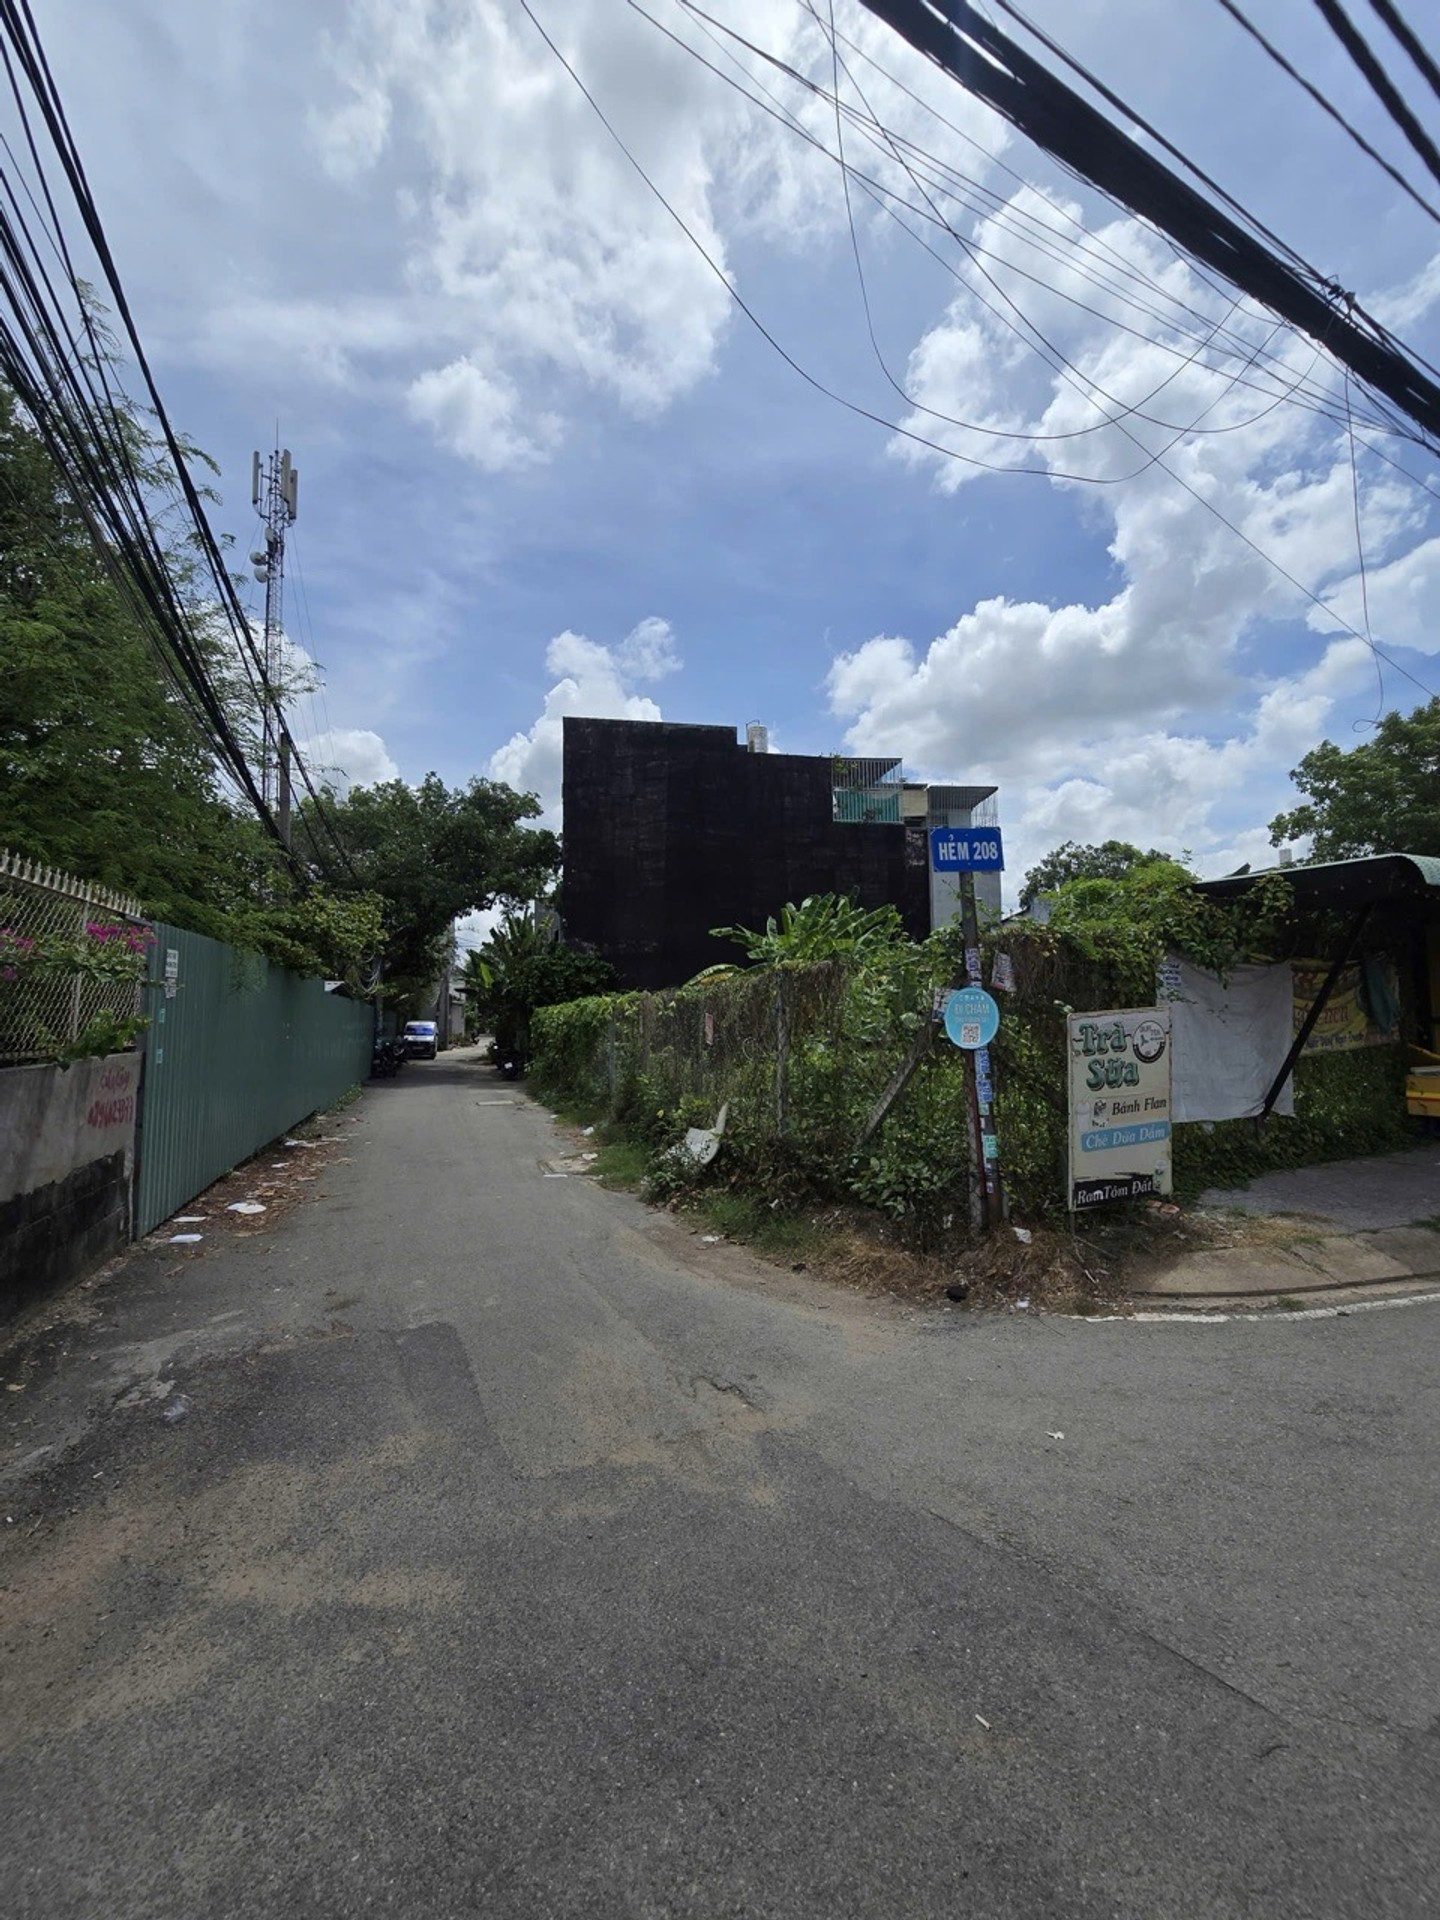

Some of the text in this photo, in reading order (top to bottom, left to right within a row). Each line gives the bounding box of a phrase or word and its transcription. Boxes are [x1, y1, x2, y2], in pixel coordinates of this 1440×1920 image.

[938, 833, 999, 861] HẺM 208
[1079, 1021, 1128, 1057] Trà
[1086, 1057, 1140, 1092] Sữa
[1111, 1096, 1167, 1116] Bánh Flan
